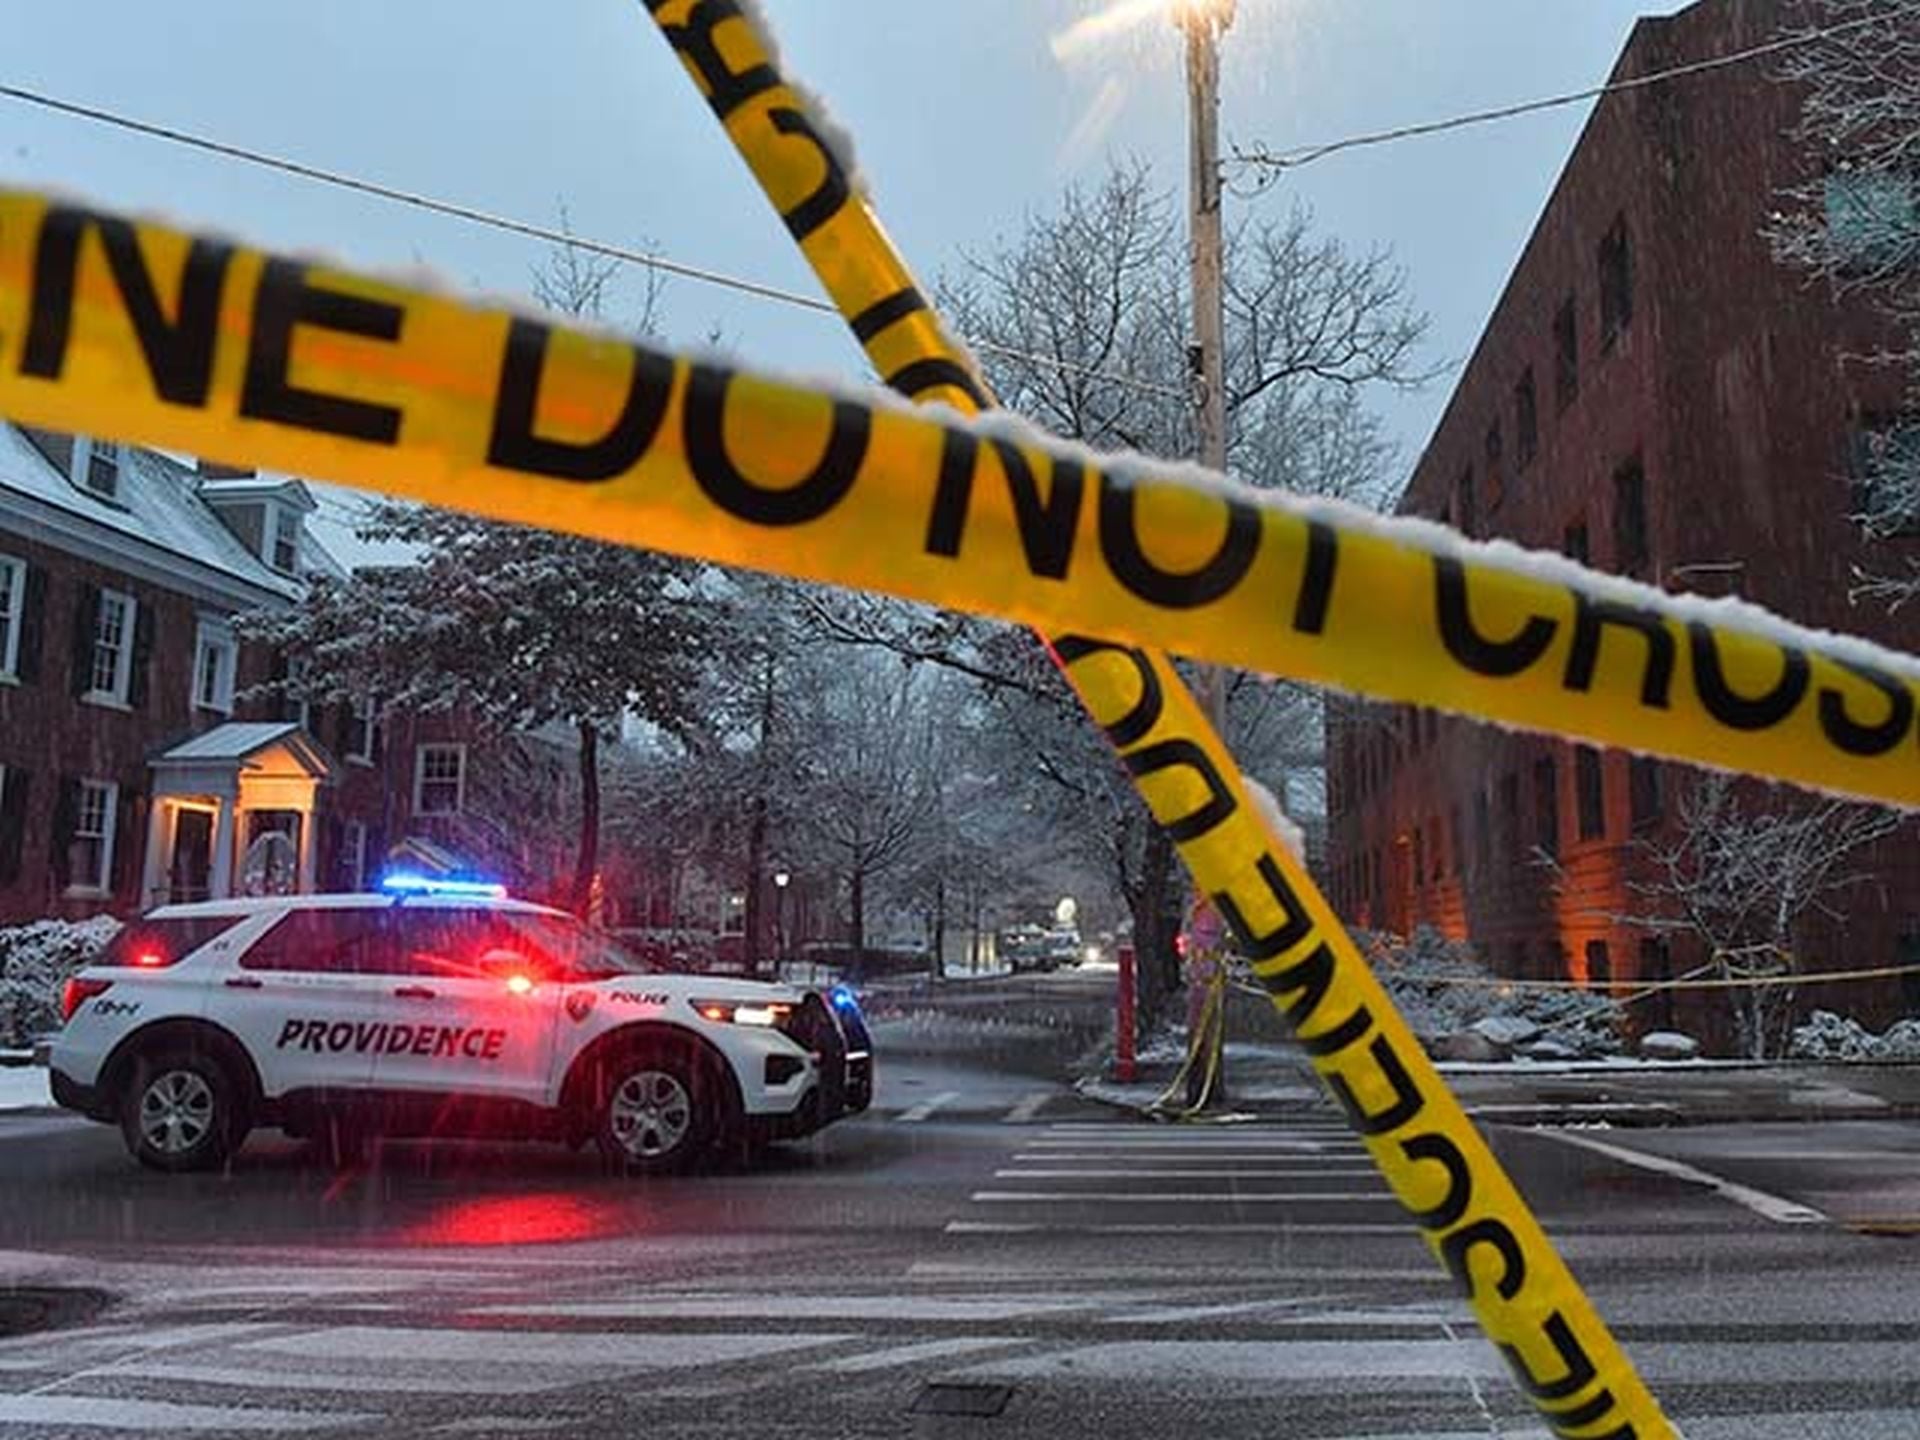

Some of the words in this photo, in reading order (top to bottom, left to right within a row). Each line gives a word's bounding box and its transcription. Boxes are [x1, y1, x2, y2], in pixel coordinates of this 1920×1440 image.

[640, 0, 850, 242] CR
[486, 315, 871, 526] DO
[924, 422, 1339, 637] NOT
[1052, 634, 1238, 843] DO
[276, 1019, 506, 1059] PROVIDENCE
[1213, 852, 1526, 1300] SCENE
